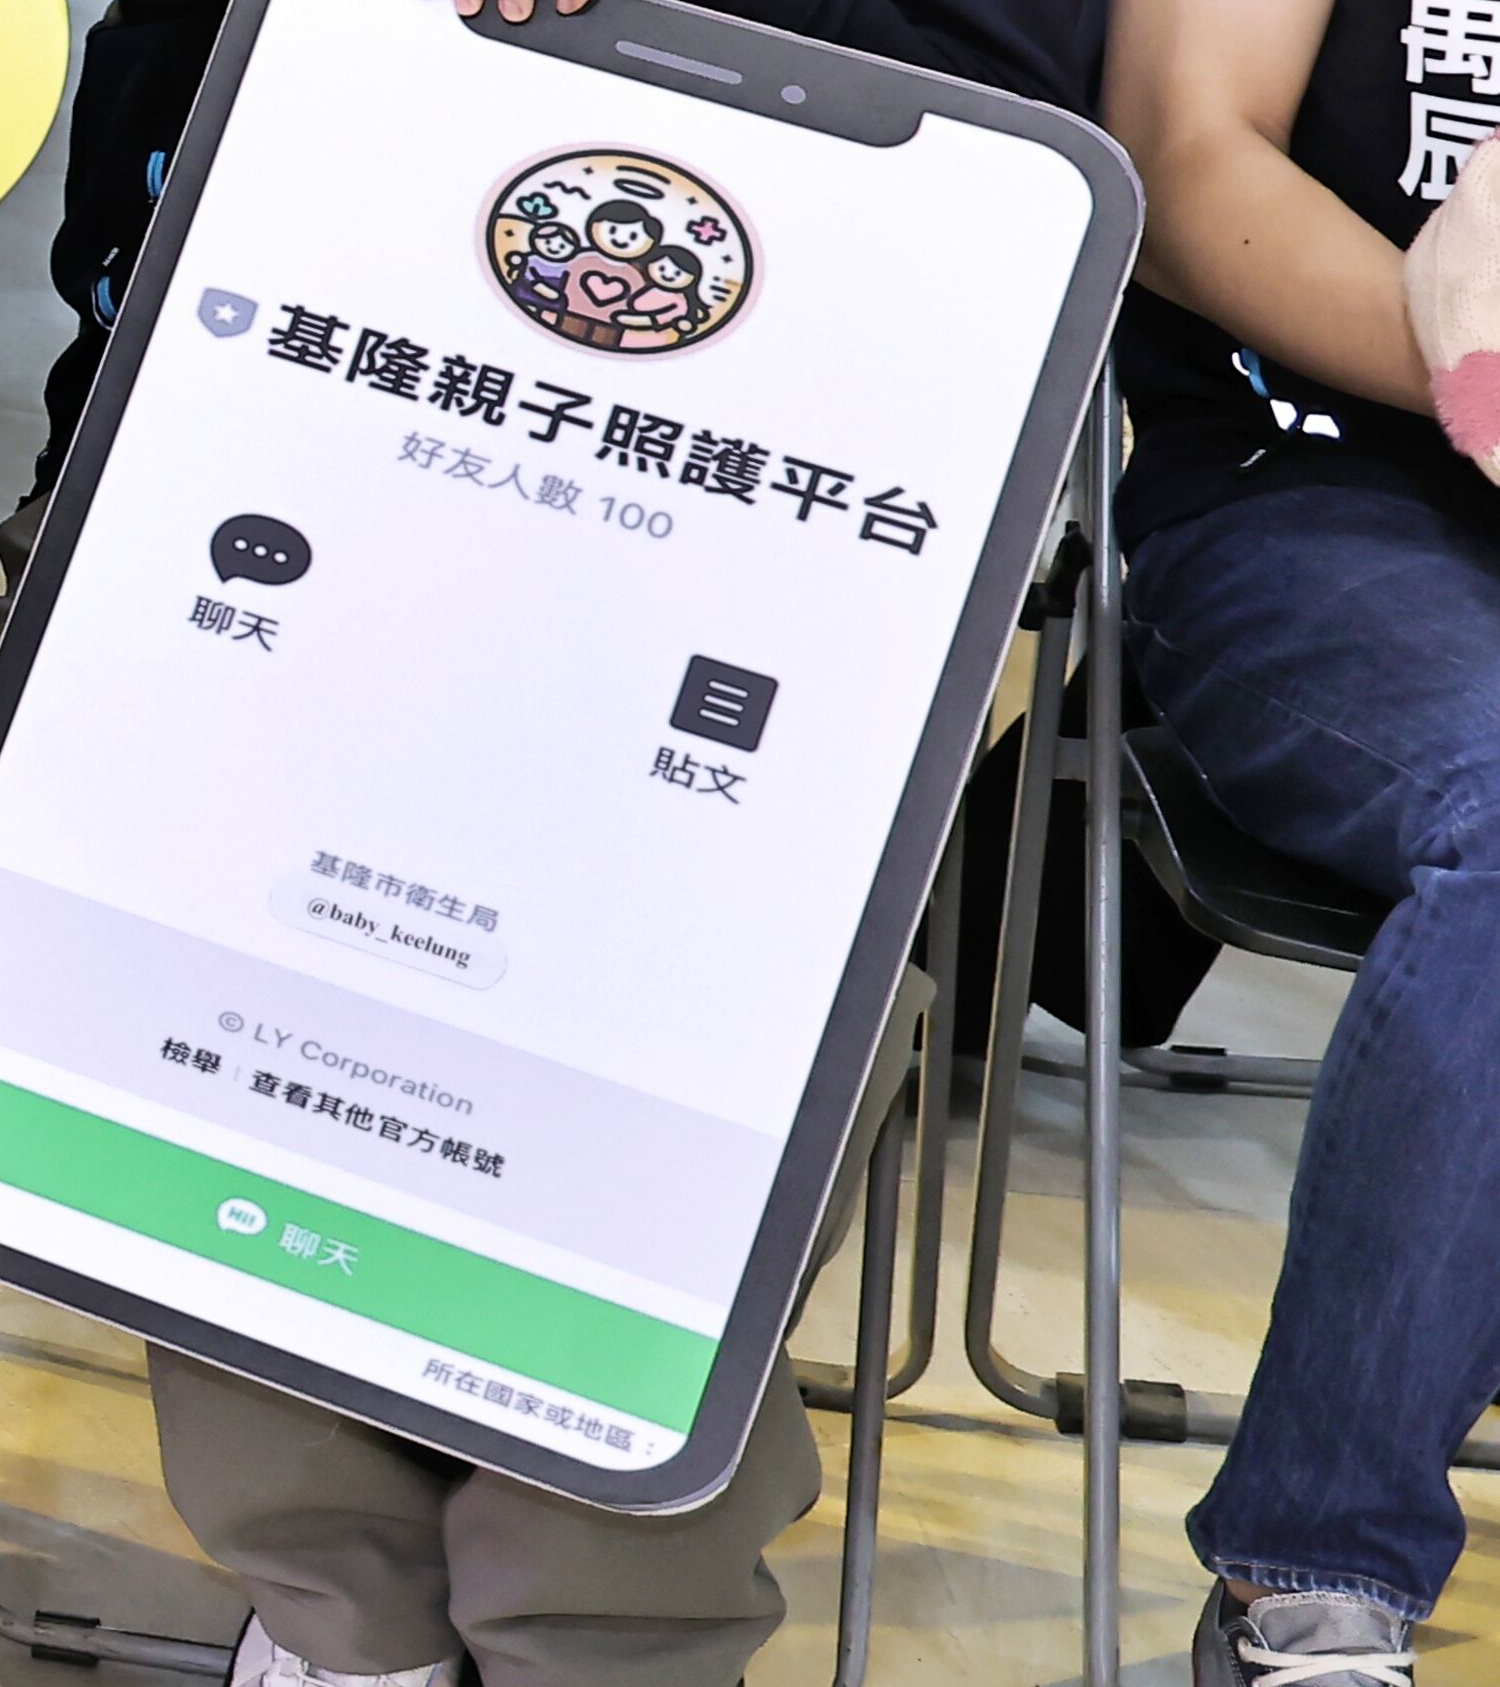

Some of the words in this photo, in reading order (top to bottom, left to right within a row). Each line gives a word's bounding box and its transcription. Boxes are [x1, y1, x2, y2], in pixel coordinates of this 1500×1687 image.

[268, 303, 940, 557] 基隆親子照護平台
[397, 431, 583, 516] 好友人數
[599, 496, 673, 540] 100
[188, 595, 279, 652] 聊天
[650, 747, 747, 805] 貼文
[307, 897, 472, 970] @baby_keelung
[310, 850, 500, 934] 基隆市衛生局
[160, 1036, 222, 1076] 檢舉
[248, 1069, 506, 1179] 查看其他官方帳號
[253, 1022, 292, 1049] LY
[299, 1040, 475, 1115] Corporation
[278, 1223, 360, 1277] 聊天
